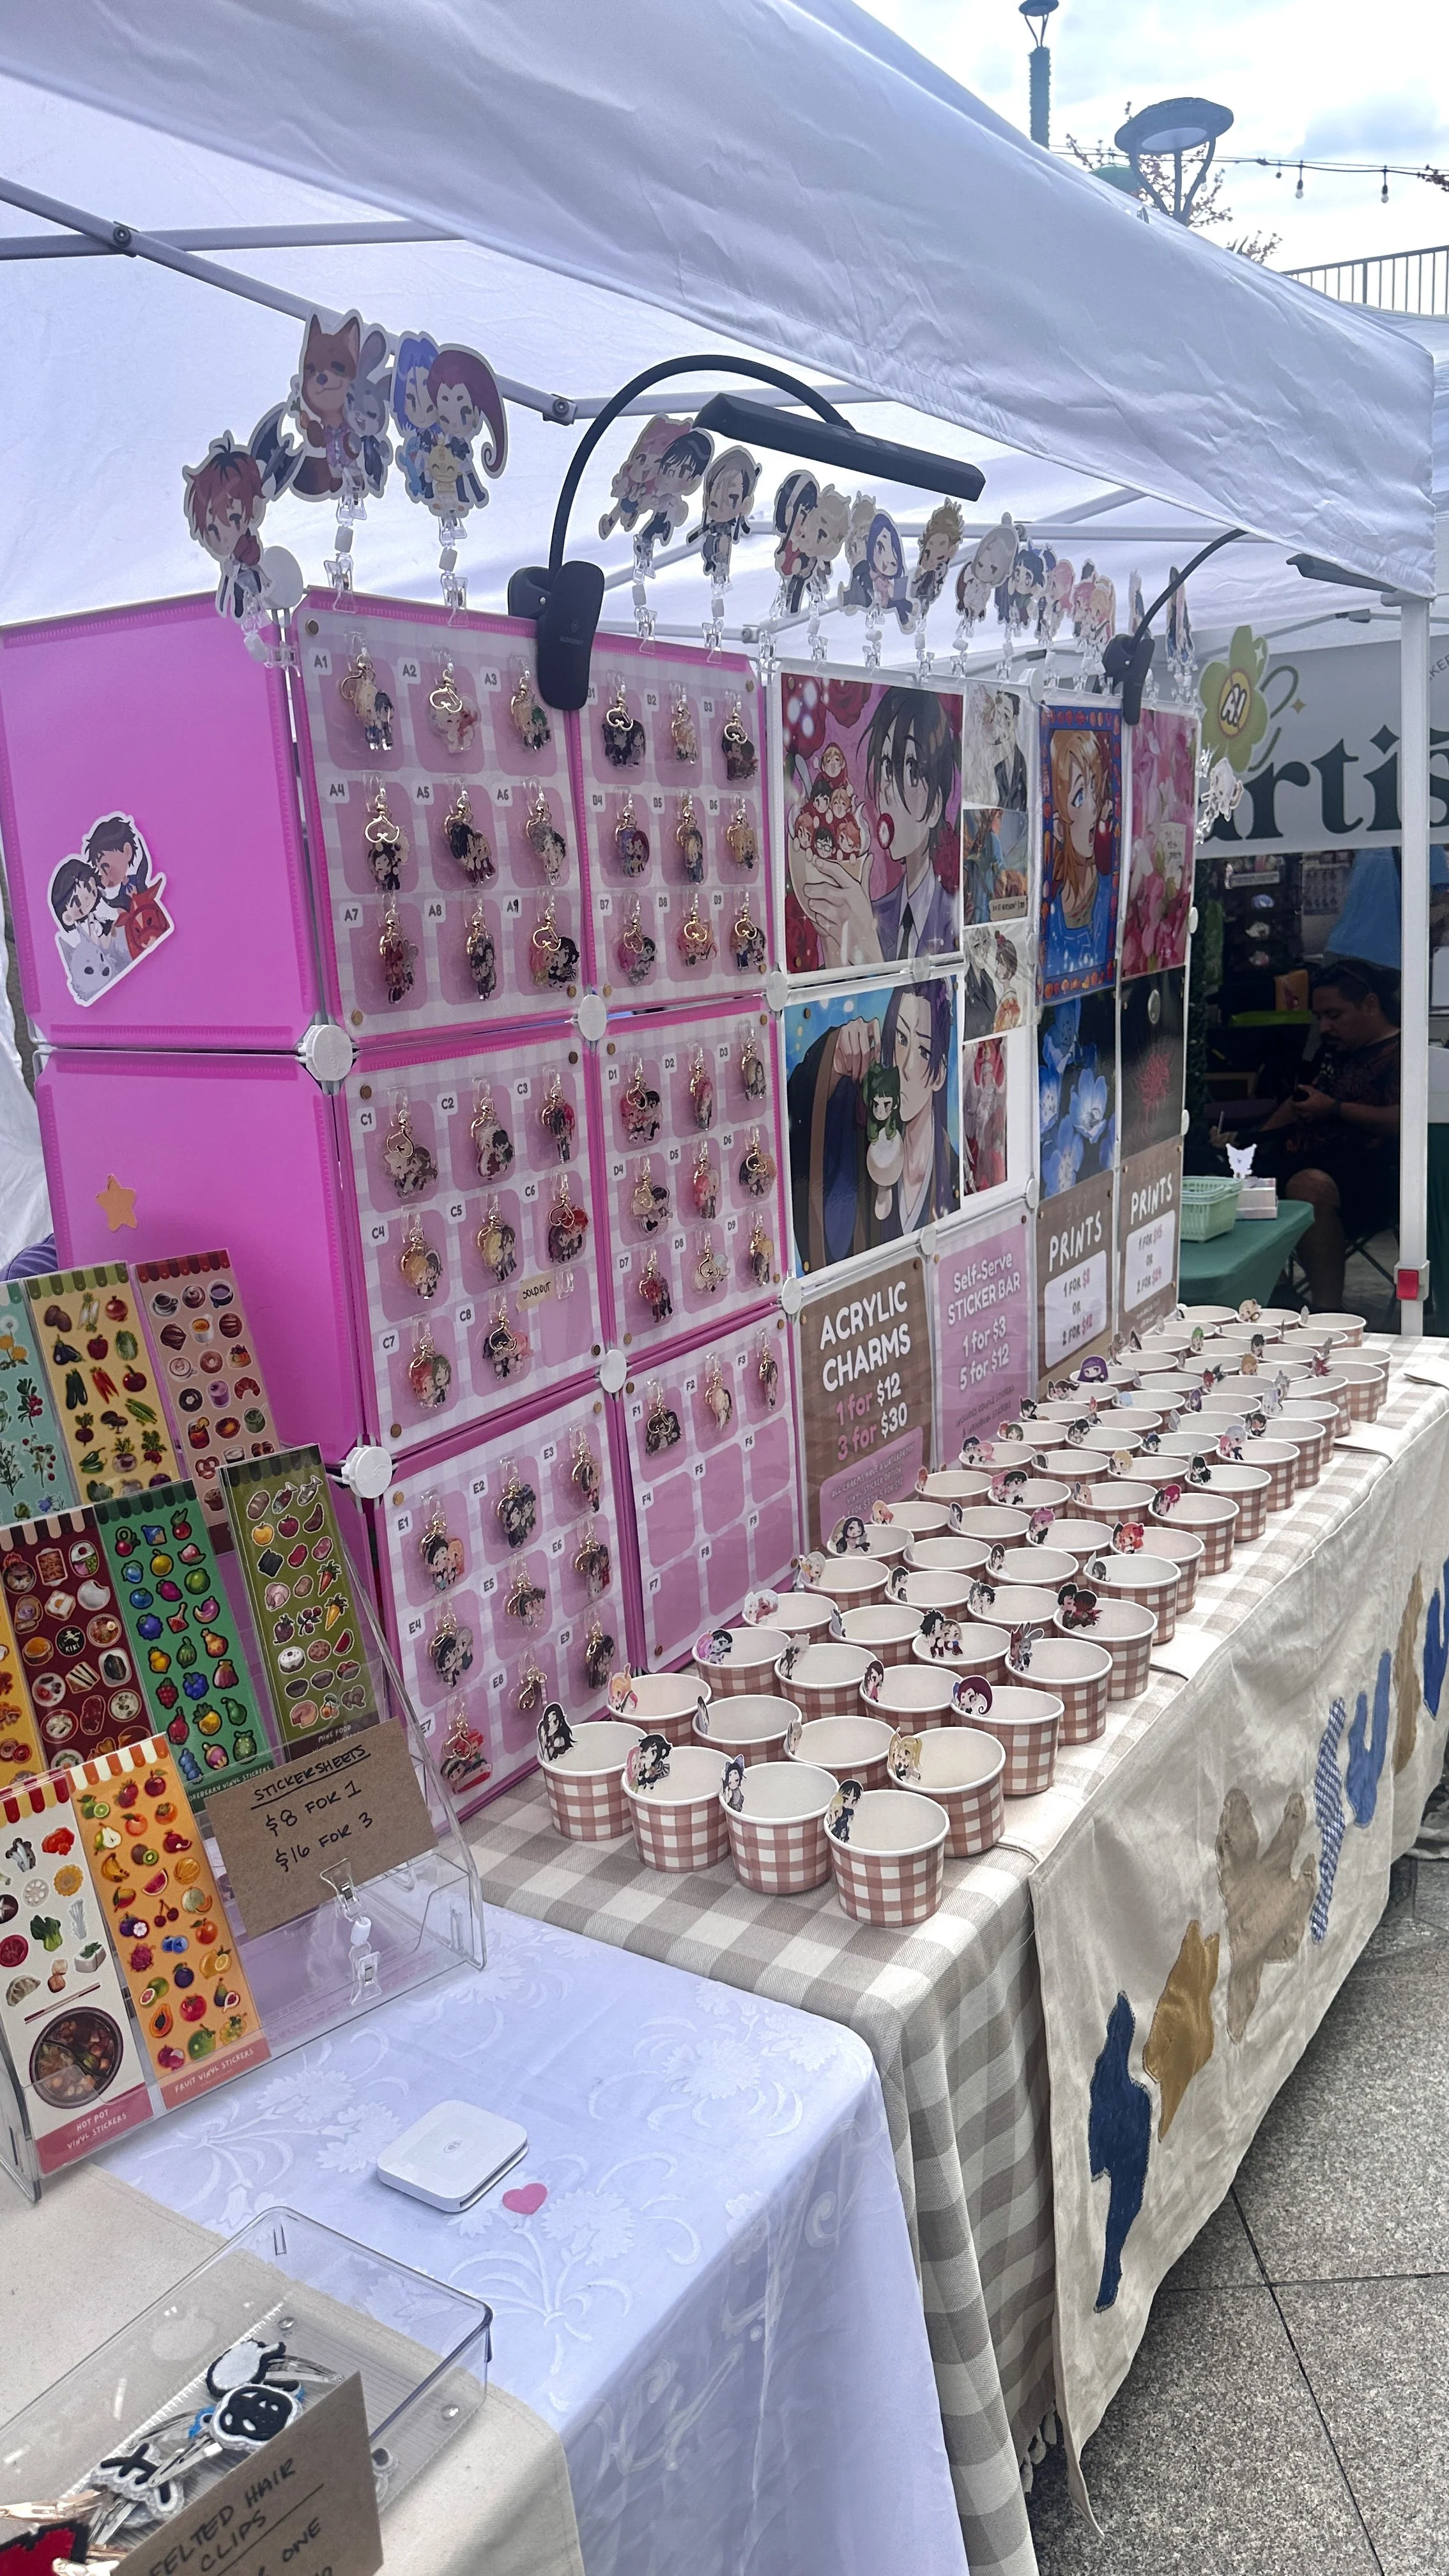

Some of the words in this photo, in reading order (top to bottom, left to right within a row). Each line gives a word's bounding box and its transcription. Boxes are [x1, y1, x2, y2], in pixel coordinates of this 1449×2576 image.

[314, 654, 328, 669] A1
[1429, 654, 1449, 681] KE
[402, 664, 417, 678] A2
[484, 673, 498, 686] A3
[647, 694, 657, 706] B2
[703, 701, 713, 712] B3
[330, 783, 345, 797] A4
[1199, 724, 1449, 842] rtis
[417, 786, 430, 799] A5
[496, 788, 509, 801] A6
[592, 794, 603, 806] B4
[653, 797, 663, 808] B5
[709, 799, 718, 810] B6
[507, 899, 519, 913] A9
[599, 899, 610, 910] B7
[658, 896, 668, 908] B8
[714, 894, 722, 905] B9
[344, 908, 358, 921] A7
[428, 904, 442, 917] A8
[719, 1047, 728, 1058] D3
[664, 1057, 675, 1069] D2
[608, 1069, 617, 1080] D1
[517, 1082, 528, 1095] C3
[441, 1097, 455, 1110] C2
[360, 1112, 372, 1126] C1
[723, 1135, 732, 1146] D6
[670, 1149, 679, 1160] D5
[613, 1164, 624, 1176] D4
[525, 1184, 535, 1197] C6
[1130, 1172, 1172, 1225] PRINTS
[450, 1204, 463, 1218] C5
[371, 1225, 385, 1239] C4
[727, 1220, 736, 1231] D9
[674, 1238, 684, 1250] D8
[1049, 1210, 1102, 1272] PRINTS
[619, 1256, 629, 1269] D7
[954, 1253, 1013, 1293] Self-Serve
[522, 1286, 539, 1300] SOLD
[539, 1281, 551, 1293] OUT
[1069, 1276, 1081, 1296] FOR
[948, 1284, 996, 1325] STICKER
[999, 1271, 1020, 1300] BAR
[1072, 1300, 1081, 1315] OR
[459, 1308, 471, 1322] C8
[820, 1281, 908, 1350] ACRYLIC
[382, 1335, 395, 1349] C7
[963, 1335, 969, 1357] 1
[971, 1330, 990, 1353] for
[993, 1315, 1006, 1342] $3
[1062, 1331, 1066, 1346] 2
[1068, 1324, 1080, 1343] FOR
[737, 1355, 746, 1366] F3
[822, 1323, 910, 1392] CHARMS
[960, 1366, 967, 1390] 5
[970, 1360, 989, 1384] for
[991, 1343, 1009, 1373] $12
[686, 1379, 695, 1391] F2
[836, 1400, 844, 1425] 1
[847, 1393, 873, 1420] for
[877, 1372, 901, 1407] $12
[632, 1405, 641, 1417] F1
[838, 1435, 848, 1460] 3
[852, 1424, 877, 1452] for
[881, 1402, 907, 1439] $30
[745, 1436, 753, 1447] F6
[544, 1446, 554, 1460] E3
[695, 1463, 703, 1476] F5
[473, 1480, 485, 1494] E2
[832, 1487, 842, 1498] ALL
[843, 1473, 864, 1491] CHARMS
[863, 1478, 883, 1494] STICKER
[641, 1492, 652, 1505] F4
[397, 1516, 409, 1531] E1
[749, 1515, 757, 1526] F9
[552, 1539, 562, 1553] E6
[701, 1545, 710, 1558] F8
[483, 1577, 494, 1592] E5
[649, 1577, 658, 1591] F7
[408, 1618, 422, 1634] E4
[560, 1630, 570, 1644] E9
[493, 1673, 504, 1689] E8
[335, 1724, 352, 1736] FOOD
[254, 1744, 367, 1802] STICKERSHEETS
[188, 1785, 221, 1802] OKEBERRY
[222, 1778, 241, 1789] VINYL
[242, 1765, 271, 1781] STICKERS
[265, 1809, 298, 1837] $8
[305, 1791, 342, 1814] FOR
[344, 1780, 362, 1799] 1
[275, 1844, 310, 1873] $16
[319, 1825, 352, 1848] FOR
[358, 1811, 373, 1828] 3
[174, 2076, 196, 2094] FRUIT
[197, 2065, 220, 2080] VINYL
[222, 2048, 254, 2069] STICKERS
[76, 2117, 92, 2132] HOT
[94, 2108, 109, 2123] POT
[67, 2132, 90, 2150] VINYL
[92, 2112, 127, 2136] STICKERS
[148, 2504, 234, 2576] FELTED
[244, 2458, 296, 2508] HAIR
[200, 2509, 267, 2573] CLIPS
[282, 2517, 321, 2563] ONE
